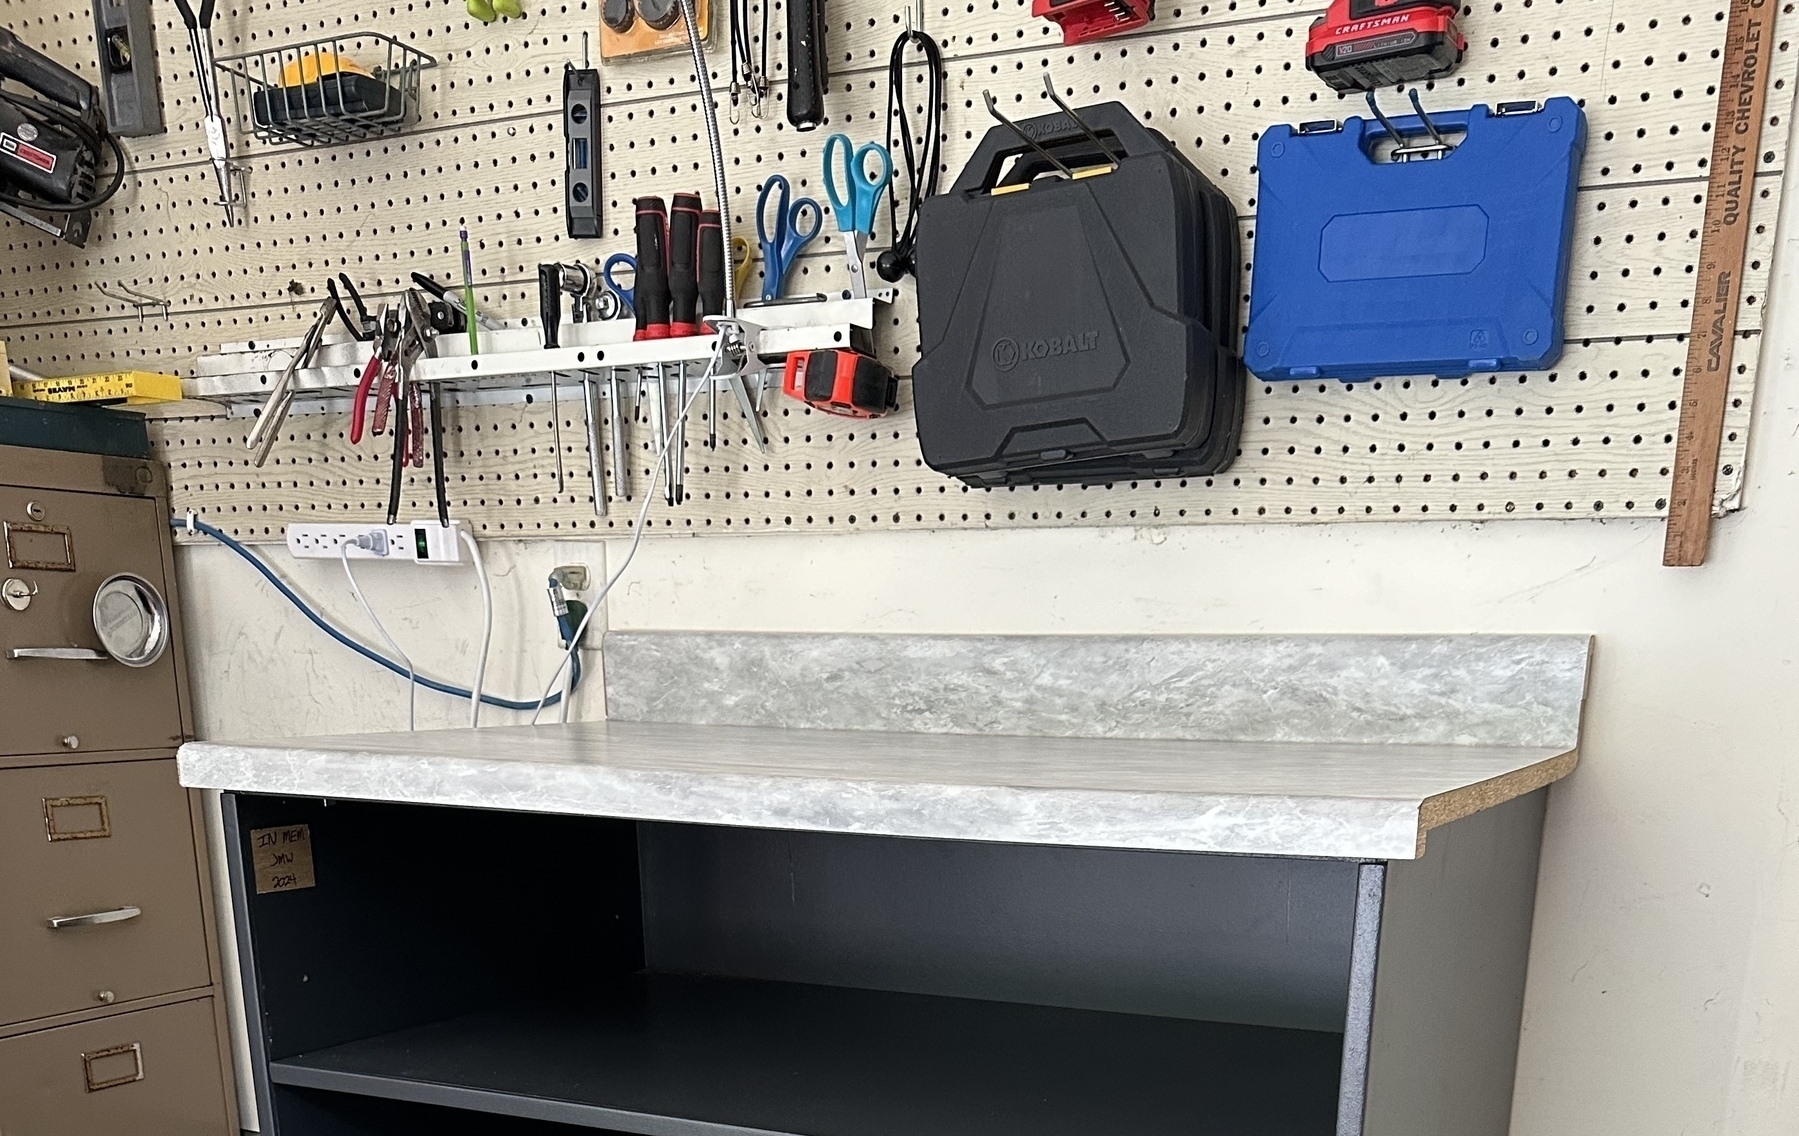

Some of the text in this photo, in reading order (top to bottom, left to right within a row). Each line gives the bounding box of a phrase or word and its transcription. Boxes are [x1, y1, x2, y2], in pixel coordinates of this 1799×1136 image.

[1335, 14, 1410, 35] CRAFTSMAN
[1338, 45, 1353, 55] V20
[1734, 36, 1745, 52] 15
[1730, 73, 1740, 89] 14
[1723, 145, 1746, 226] QUALITY
[1735, 19, 1762, 135] CHEVROLET
[1725, 110, 1735, 125] 13
[1720, 147, 1730, 162] 12
[1716, 184, 1726, 198] 11
[1711, 219, 1721, 233] 10
[1707, 270, 1731, 372] CAVALIER
[1022, 331, 1100, 362] KOBALT
[257, 828, 305, 848] IN MEM
[271, 852, 294, 867] JMW
[272, 873, 297, 889] 2024
